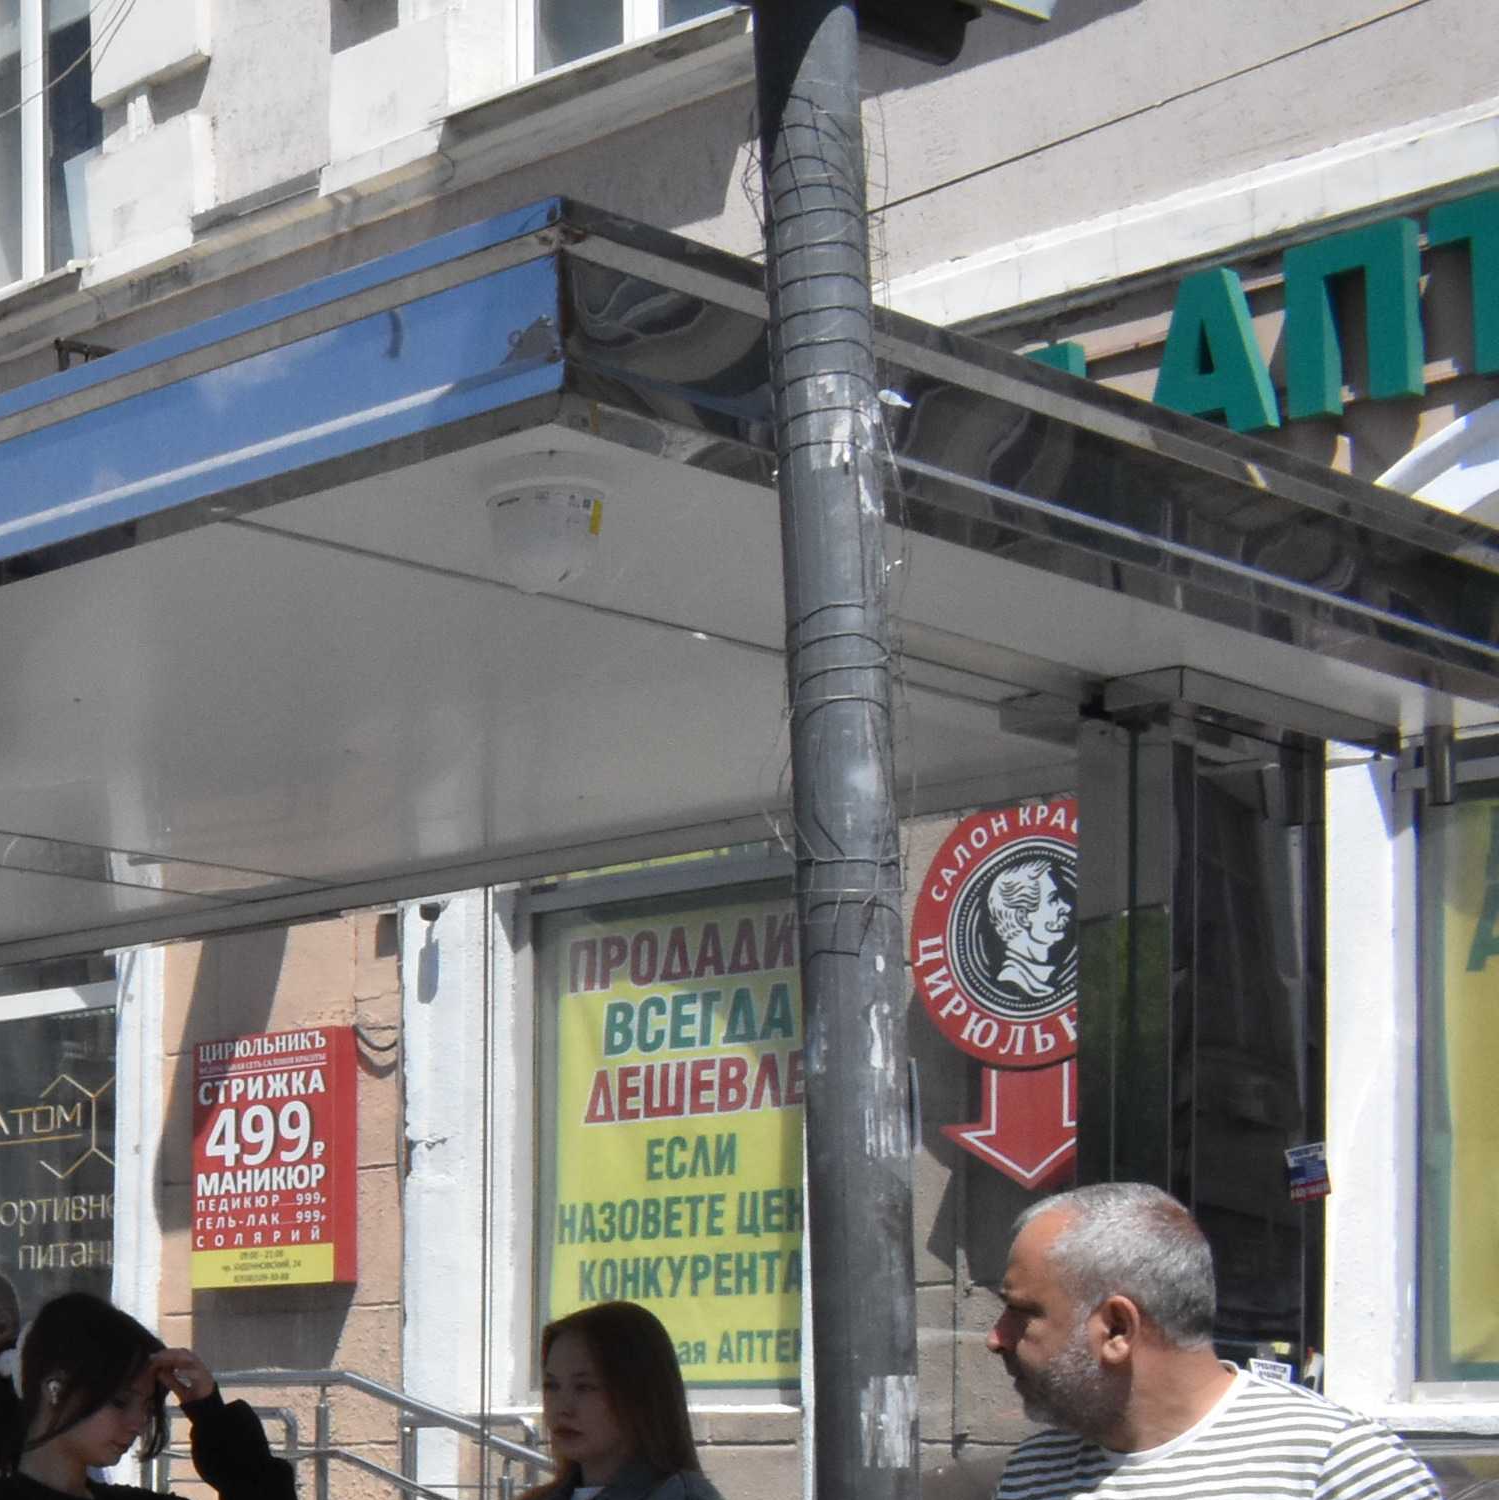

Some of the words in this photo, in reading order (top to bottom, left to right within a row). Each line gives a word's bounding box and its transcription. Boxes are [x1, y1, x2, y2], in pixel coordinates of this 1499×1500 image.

[1153, 190, 1499, 433] АПТ
[932, 814, 1008, 902] САЛОН
[569, 912, 795, 993] ПРОДАДИ
[604, 982, 795, 1057] ВСЕГДА
[915, 934, 1077, 1057] ЦИРЮЛЬН
[199, 1030, 327, 1063] ЦИРЮЛЬНИКЪ
[198, 1068, 326, 1105] СТРИЖКА
[584, 1049, 805, 1124] ДЕШЕВЛЕ
[197, 1163, 325, 1197] МАНИКЮР
[646, 1132, 738, 1181] ЕСЛИ
[196, 1194, 280, 1213] ПЕДИКЮР
[196, 1212, 280, 1231] ГЕЛЬ-ЛАК
[558, 1194, 726, 1244] НАЗОВЕТЕ
[736, 1188, 804, 1238] ЦЕН
[18, 1240, 115, 1271] питан
[196, 1225, 321, 1248] СОЛЯРИЙ
[578, 1250, 802, 1300] КОНКУРЕНТА
